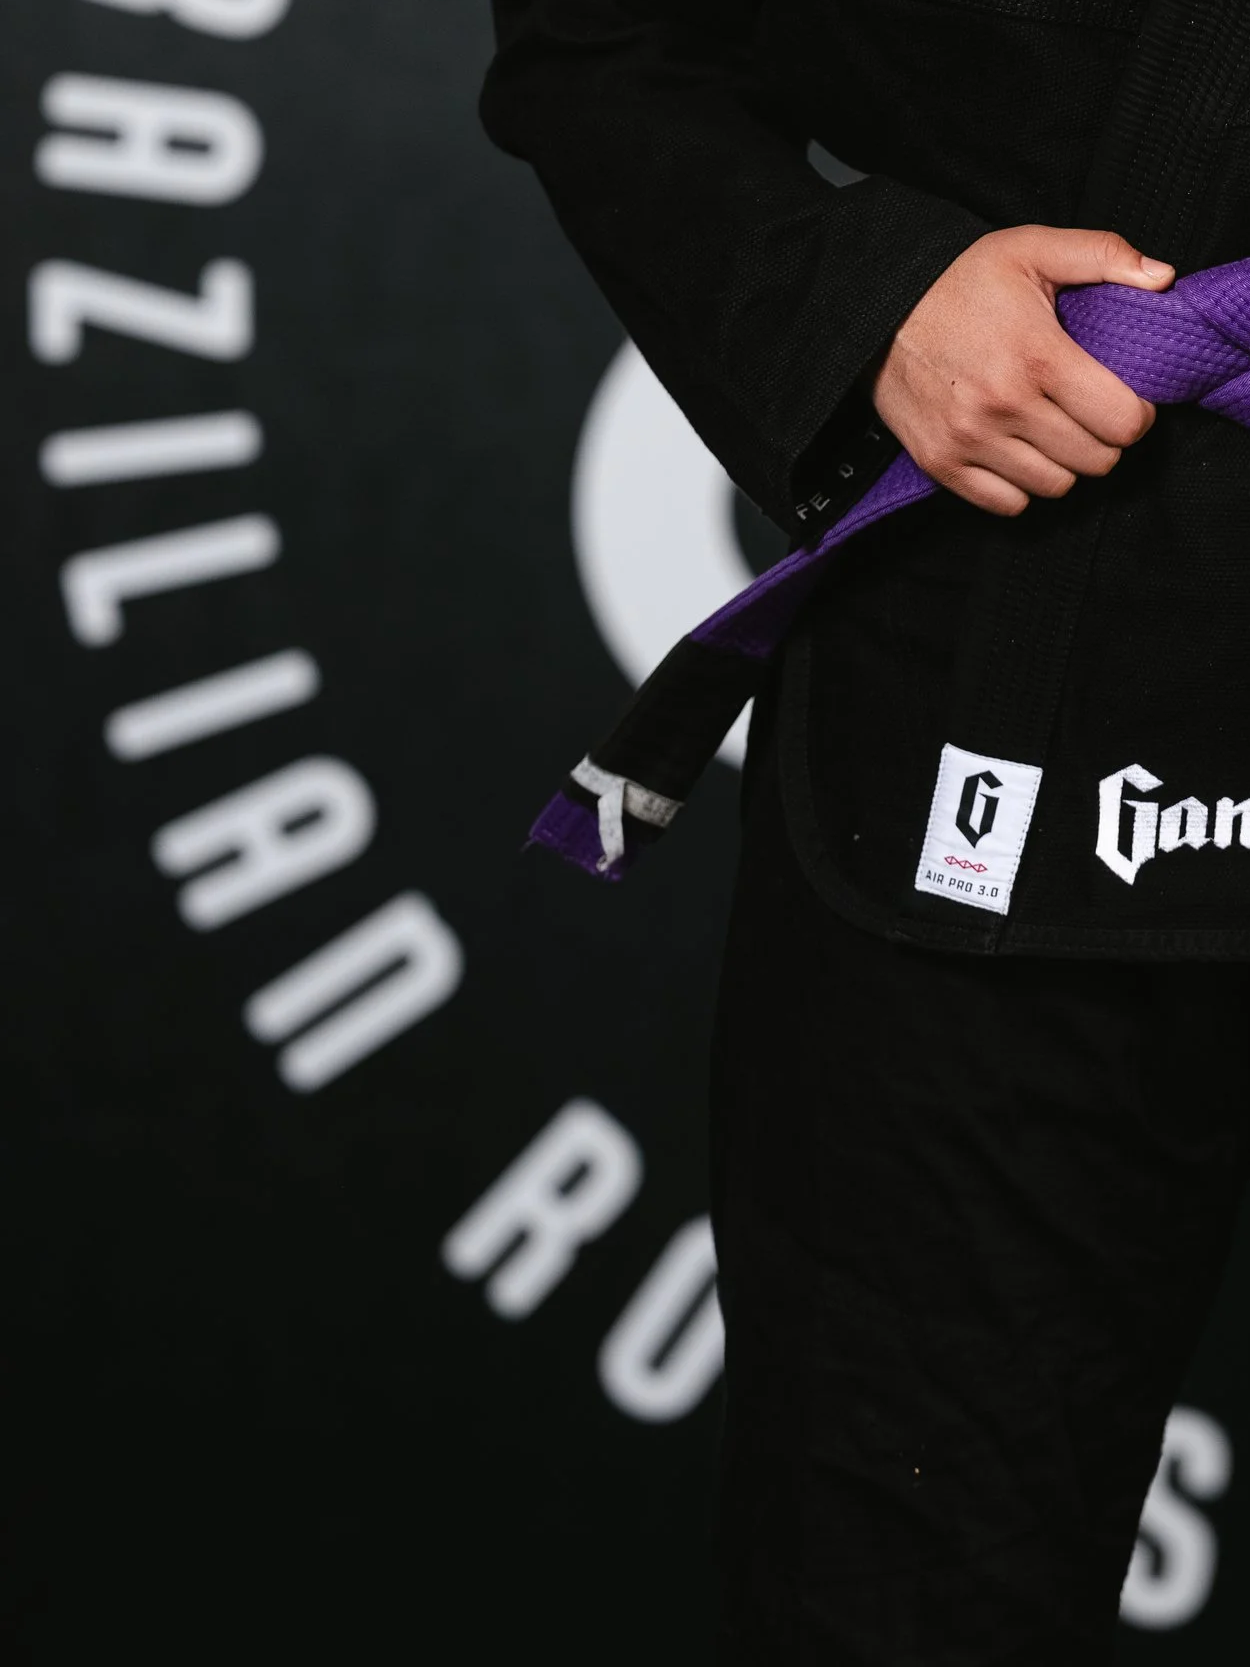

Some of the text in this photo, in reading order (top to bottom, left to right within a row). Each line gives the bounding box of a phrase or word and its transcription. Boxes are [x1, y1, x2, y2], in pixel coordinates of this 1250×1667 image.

[955, 770, 1003, 850] G
[925, 869, 999, 898] AIR PRO 3.0
